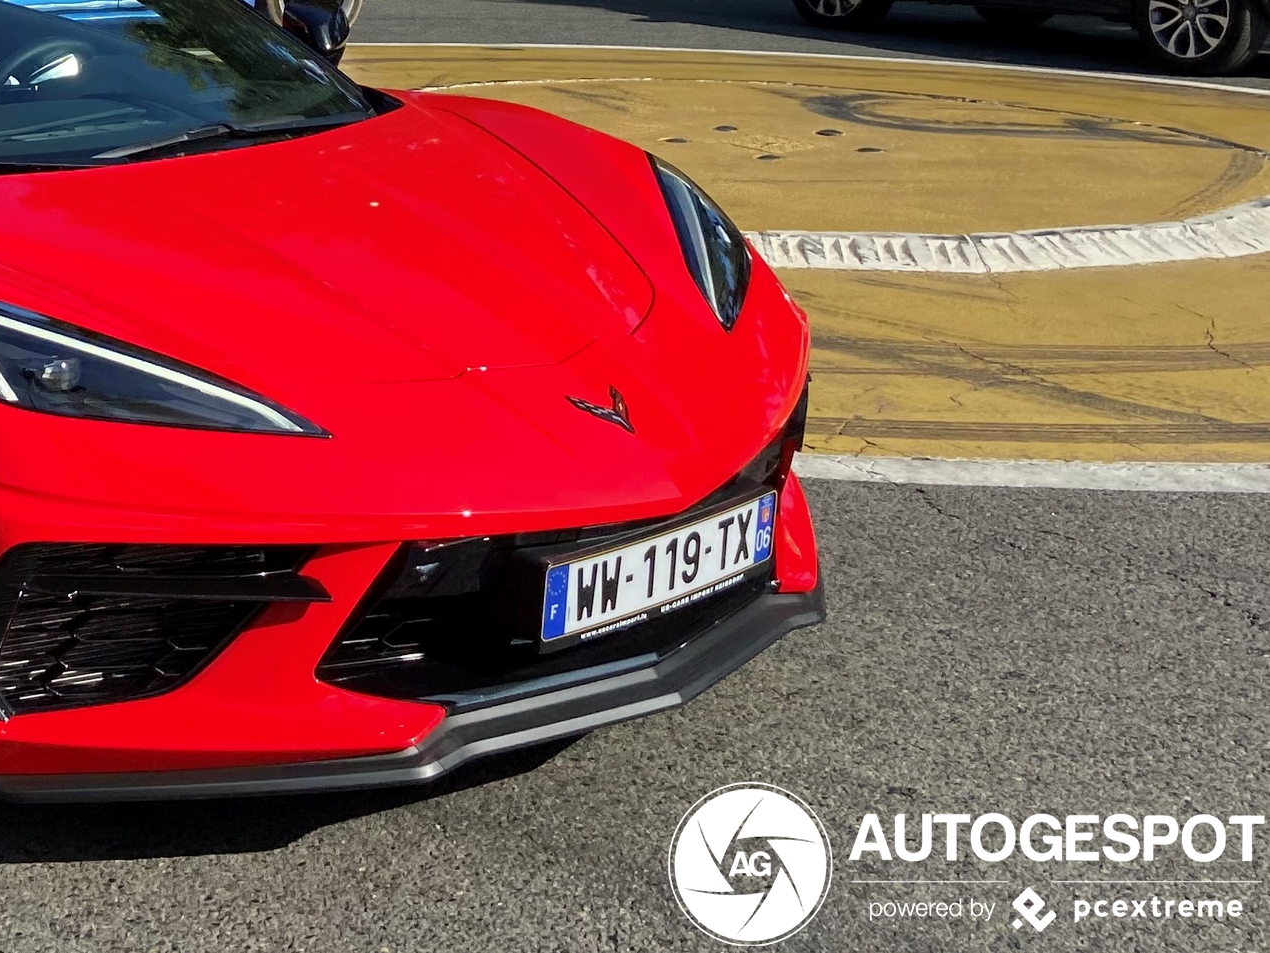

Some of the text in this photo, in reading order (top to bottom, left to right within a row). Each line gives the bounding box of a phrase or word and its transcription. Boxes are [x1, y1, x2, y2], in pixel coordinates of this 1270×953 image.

[756, 525, 772, 552] 06
[576, 508, 753, 622] WW-119-TX
[690, 586, 714, 601] IMPORT
[550, 604, 559, 620] F
